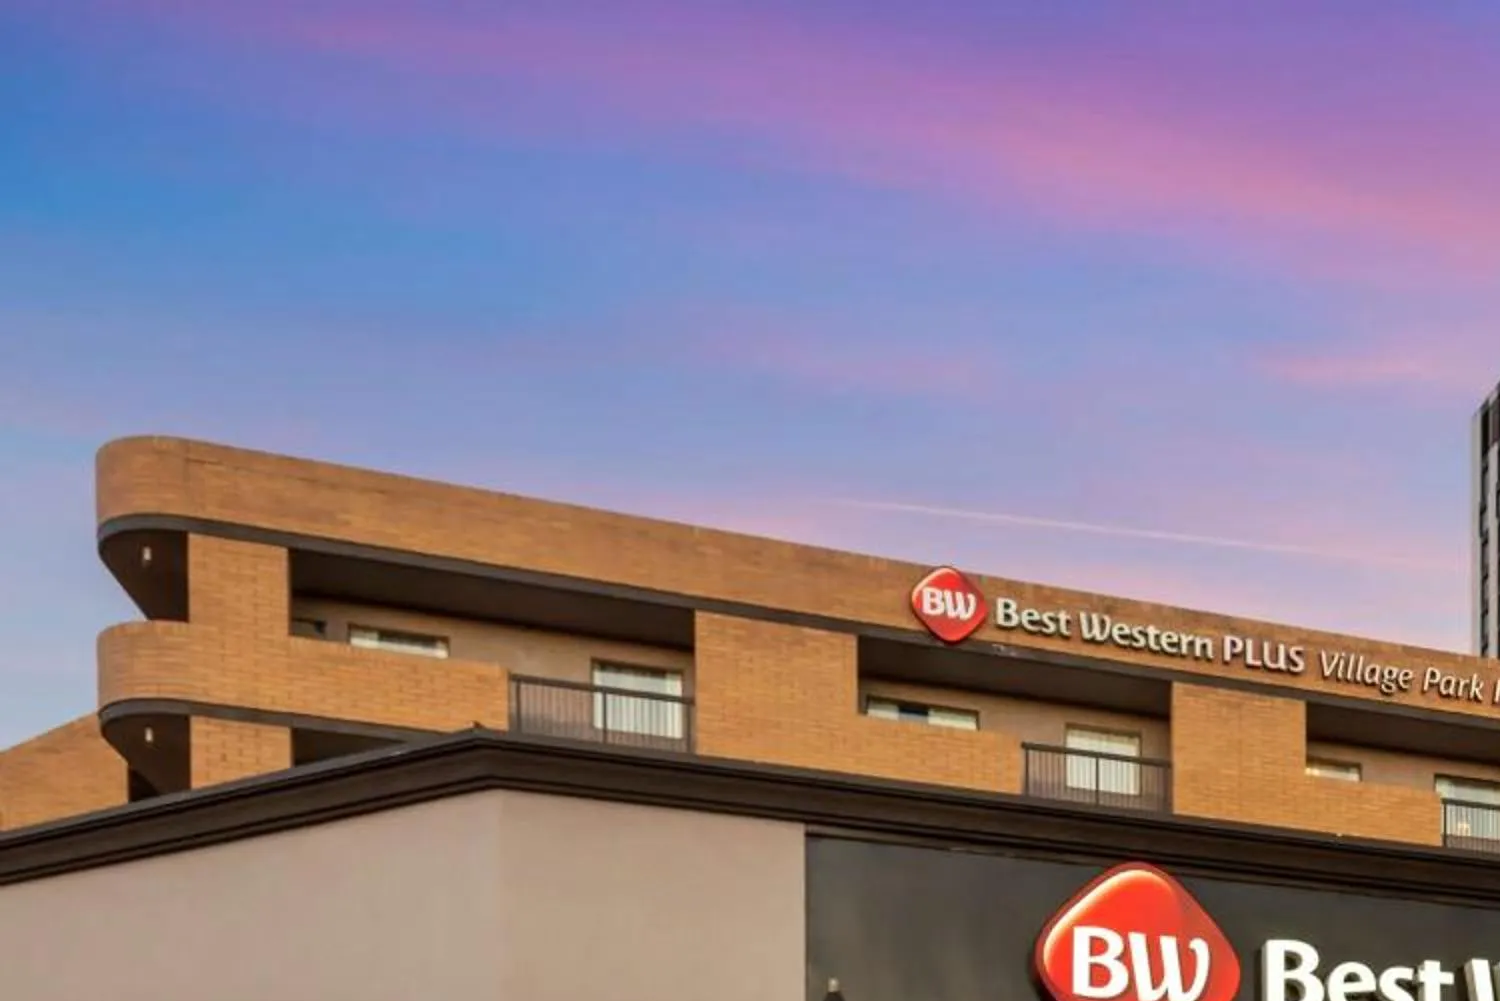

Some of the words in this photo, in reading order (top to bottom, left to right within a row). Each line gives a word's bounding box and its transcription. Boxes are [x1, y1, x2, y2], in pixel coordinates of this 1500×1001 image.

[921, 586, 978, 622] BW
[995, 597, 1071, 637] Best
[1079, 610, 1215, 660] Western
[1223, 633, 1306, 675] PLUS
[1319, 649, 1413, 695] Village
[1423, 666, 1485, 702] Park
